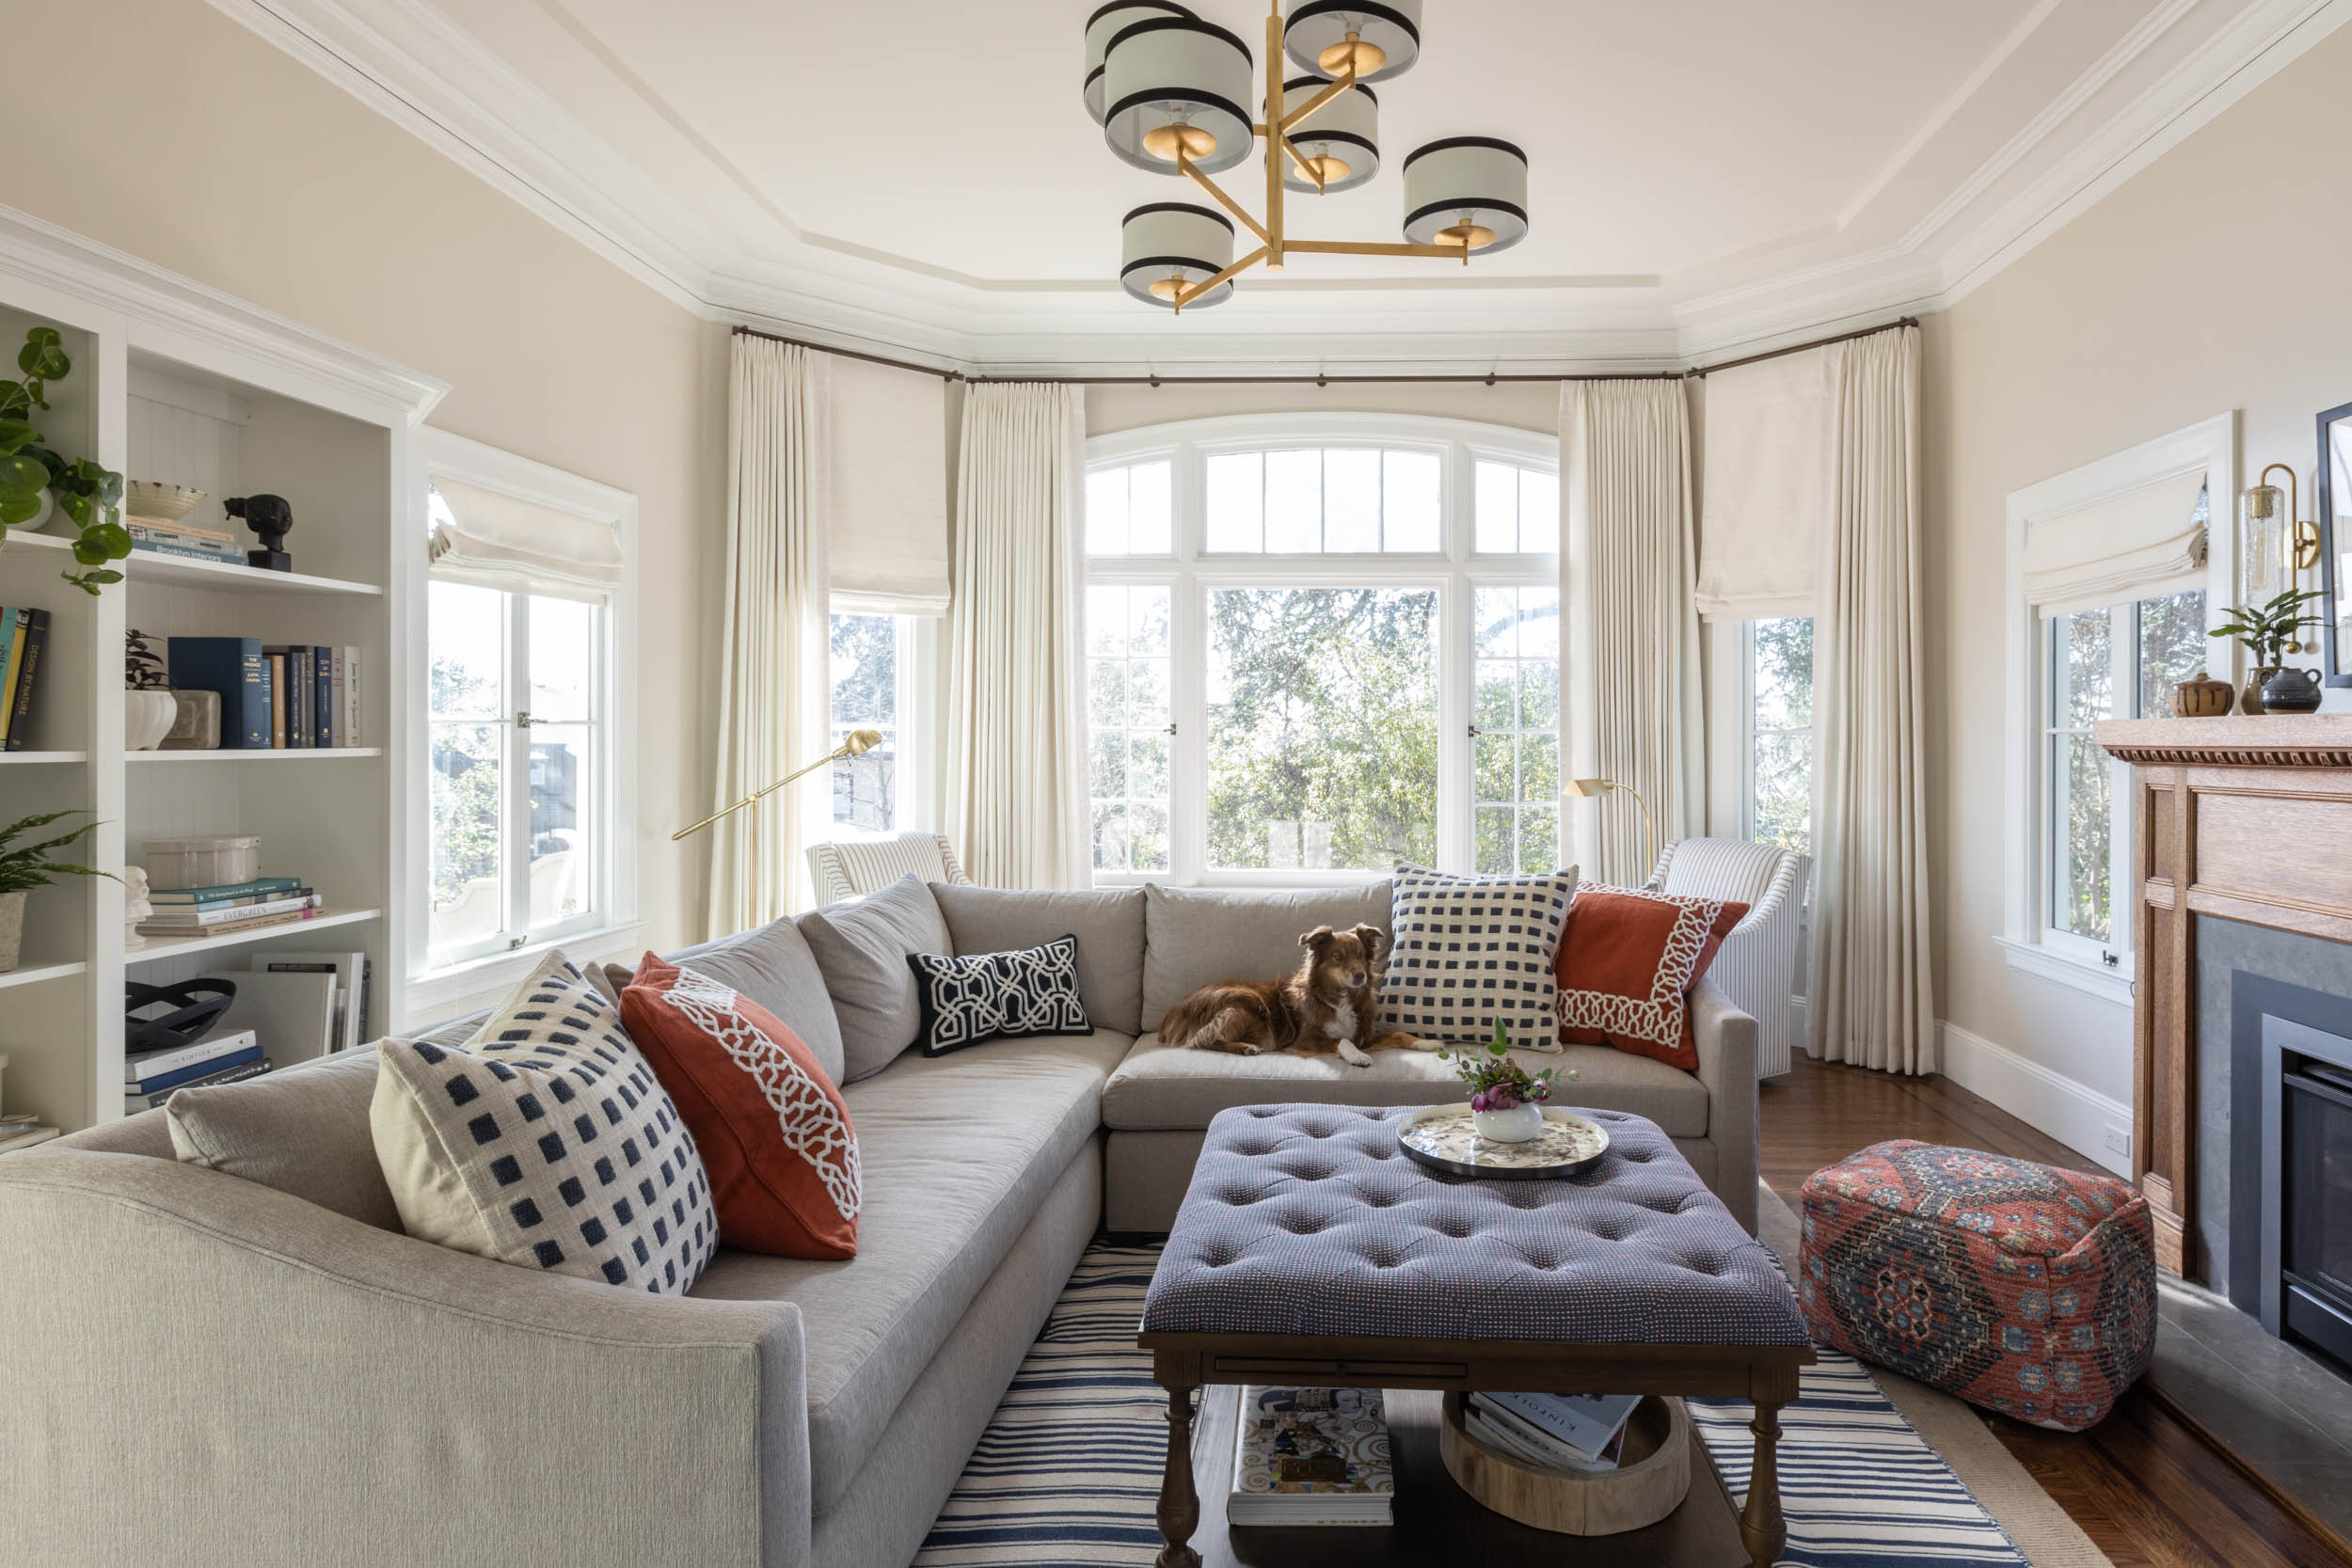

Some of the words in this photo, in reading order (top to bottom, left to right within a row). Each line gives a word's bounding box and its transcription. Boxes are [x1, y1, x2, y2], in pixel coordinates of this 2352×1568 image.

[156, 545, 190, 557] Brooklyn
[191, 550, 221, 562] Interiors
[26, 644, 39, 673] DESIGN
[18, 684, 31, 716] NATURE
[224, 907, 266, 920] EVERGREEN
